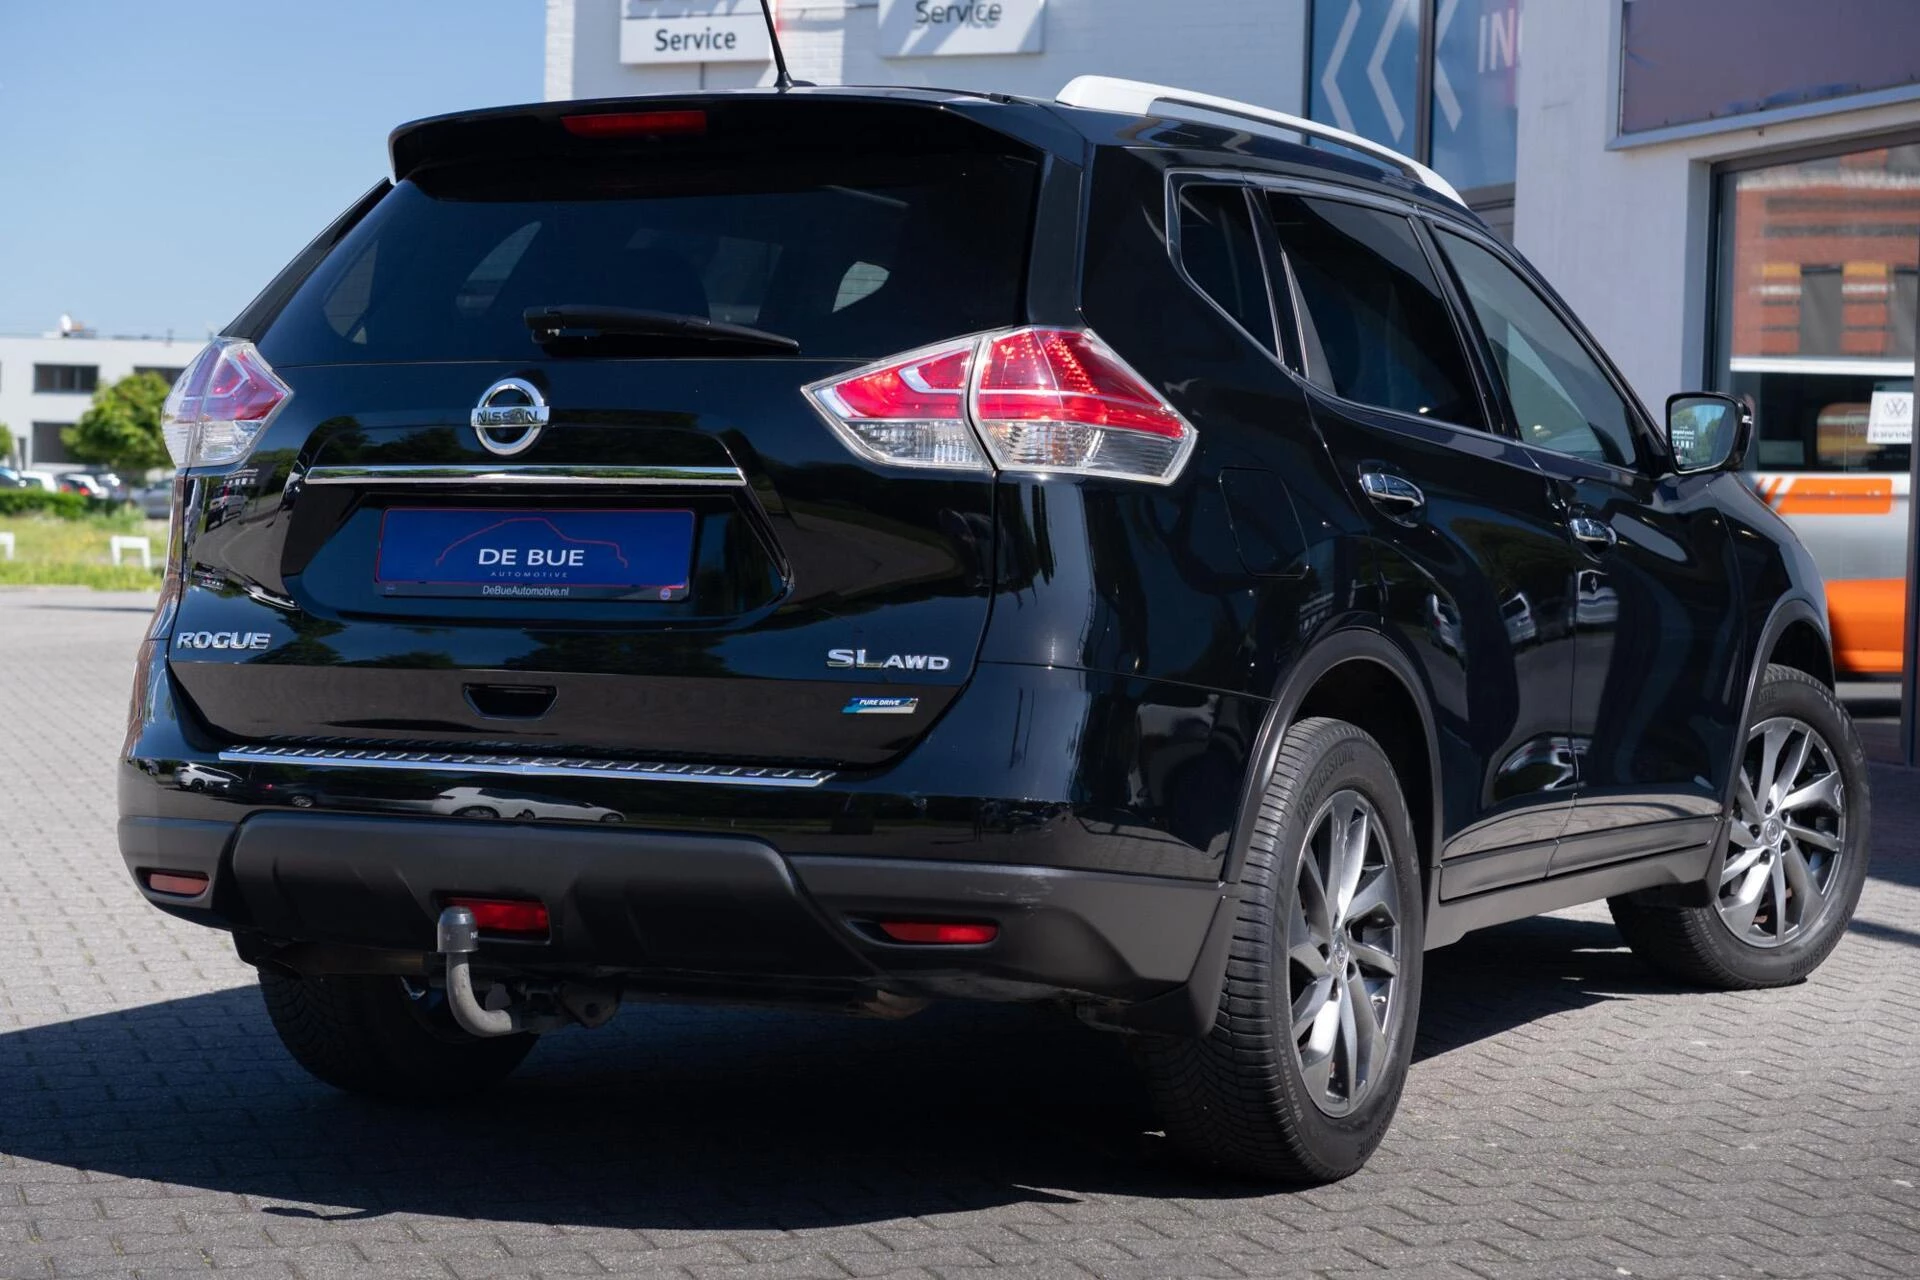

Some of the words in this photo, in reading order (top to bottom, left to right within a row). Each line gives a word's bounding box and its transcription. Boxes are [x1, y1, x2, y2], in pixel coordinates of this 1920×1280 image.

[916, 0, 1002, 23] Service
[655, 27, 736, 52] Service
[1478, 8, 1522, 73] IN
[476, 410, 539, 425] NISSAN
[478, 548, 518, 566] DE
[527, 549, 585, 566] BUE
[482, 585, 570, 597] DeBueAutomotive.nl
[176, 631, 272, 650] ROGUE
[827, 649, 882, 668] SL
[883, 655, 950, 671] AWD
